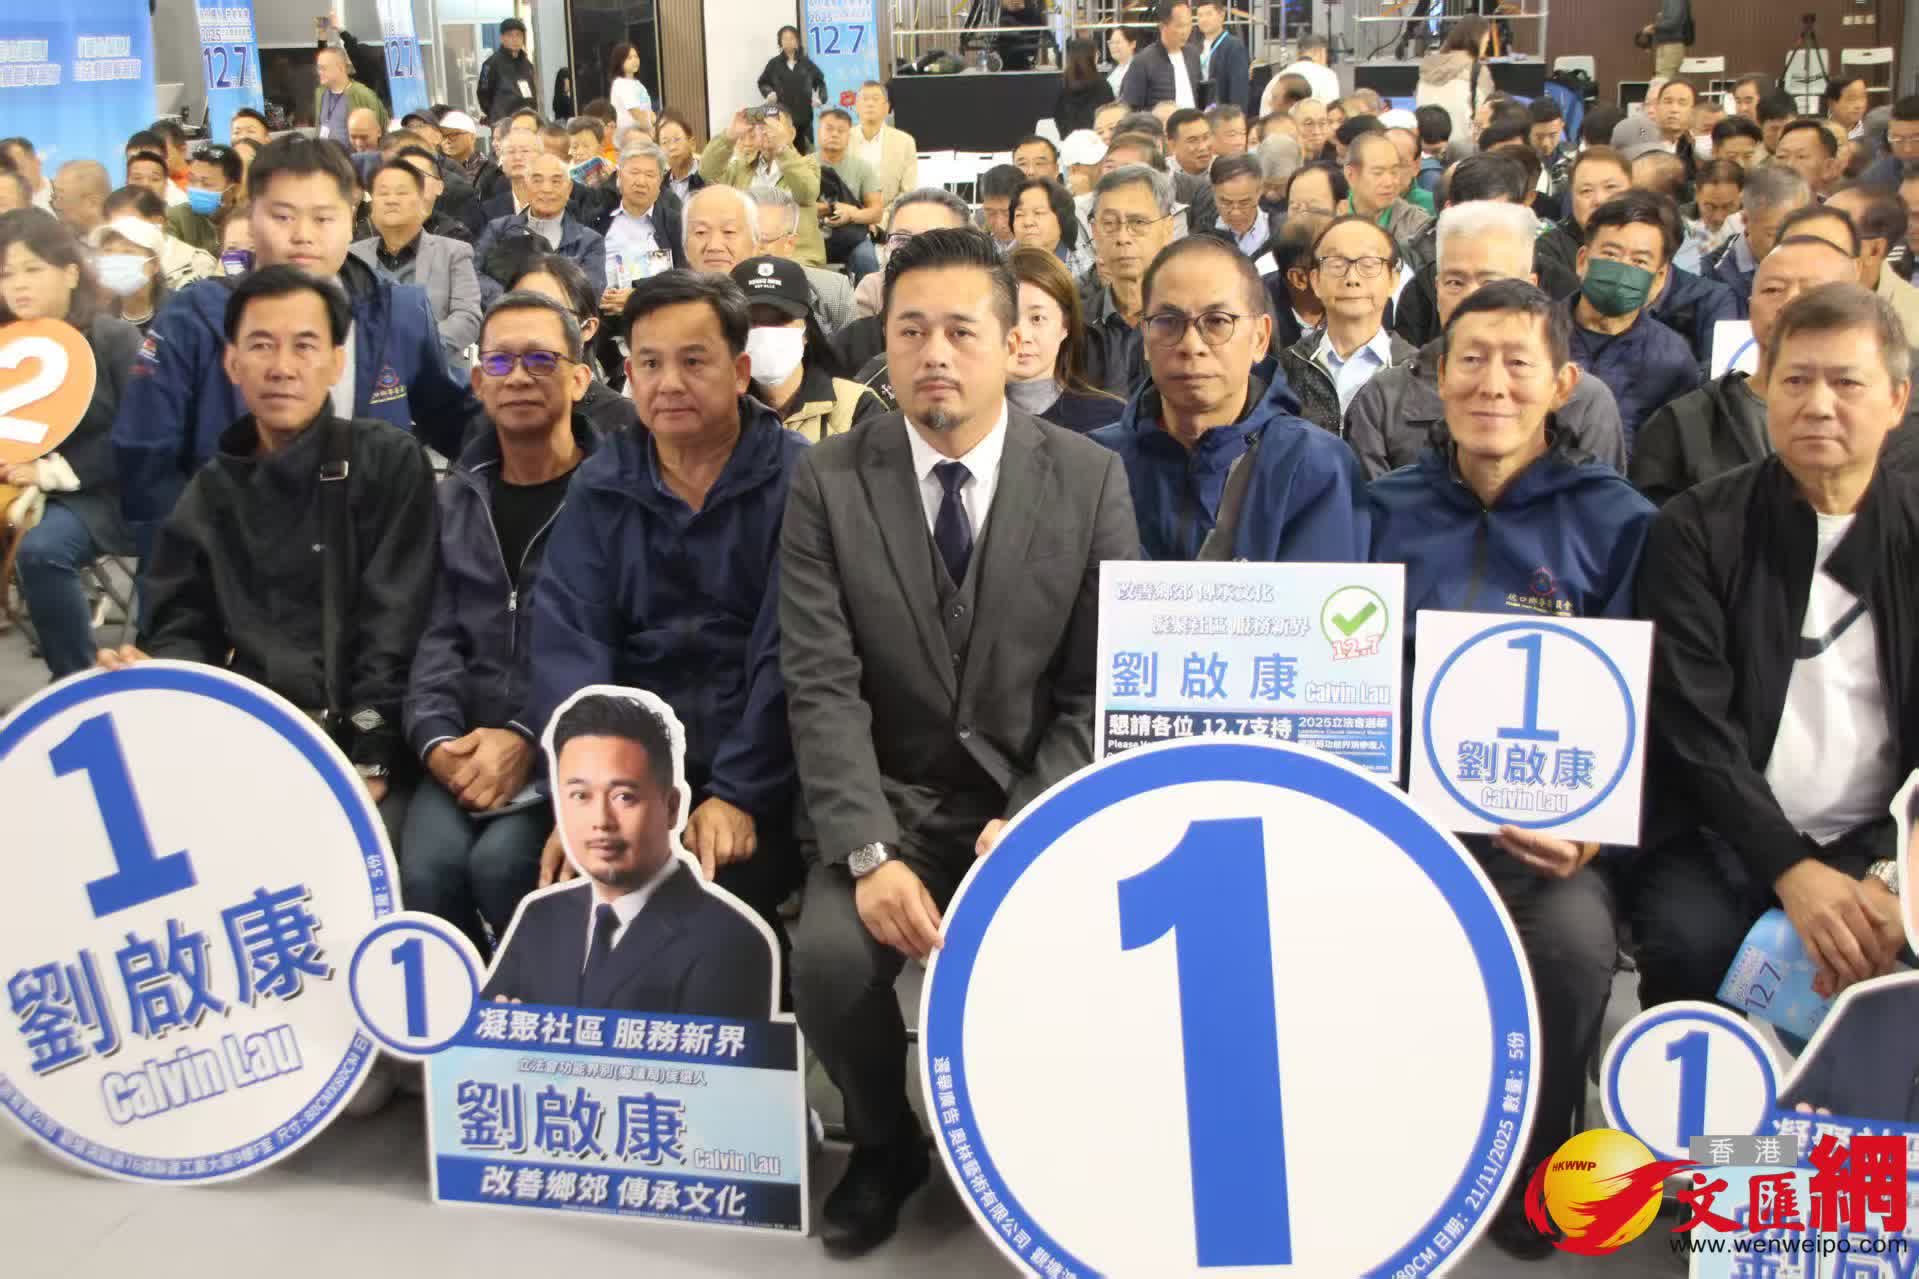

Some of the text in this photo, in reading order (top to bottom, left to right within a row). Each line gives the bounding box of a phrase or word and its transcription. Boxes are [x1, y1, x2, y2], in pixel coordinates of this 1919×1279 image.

[0, 336, 69, 445] 2
[1304, 680, 1393, 706] Calvin Lau
[1332, 635, 1381, 661] 12.7
[1496, 633, 1560, 743] 1
[1456, 740, 1597, 790] 劉啟康
[1481, 788, 1569, 814] Calvin Lau
[48, 712, 199, 919] 1
[6, 884, 336, 1079] 劉啟康
[390, 937, 429, 1039] 1
[101, 1046, 228, 1126] Calvin
[221, 1024, 304, 1088] Lau
[473, 1008, 747, 1059] 凝聚社區 服務新界
[1117, 816, 1293, 1268] 1
[456, 1078, 689, 1166] 劉啟康
[1665, 1030, 1710, 1148] 1
[480, 1164, 610, 1206] 改善鄉郊
[616, 1174, 748, 1219] 傳承文化
[693, 1147, 783, 1177] Calvin Lau
